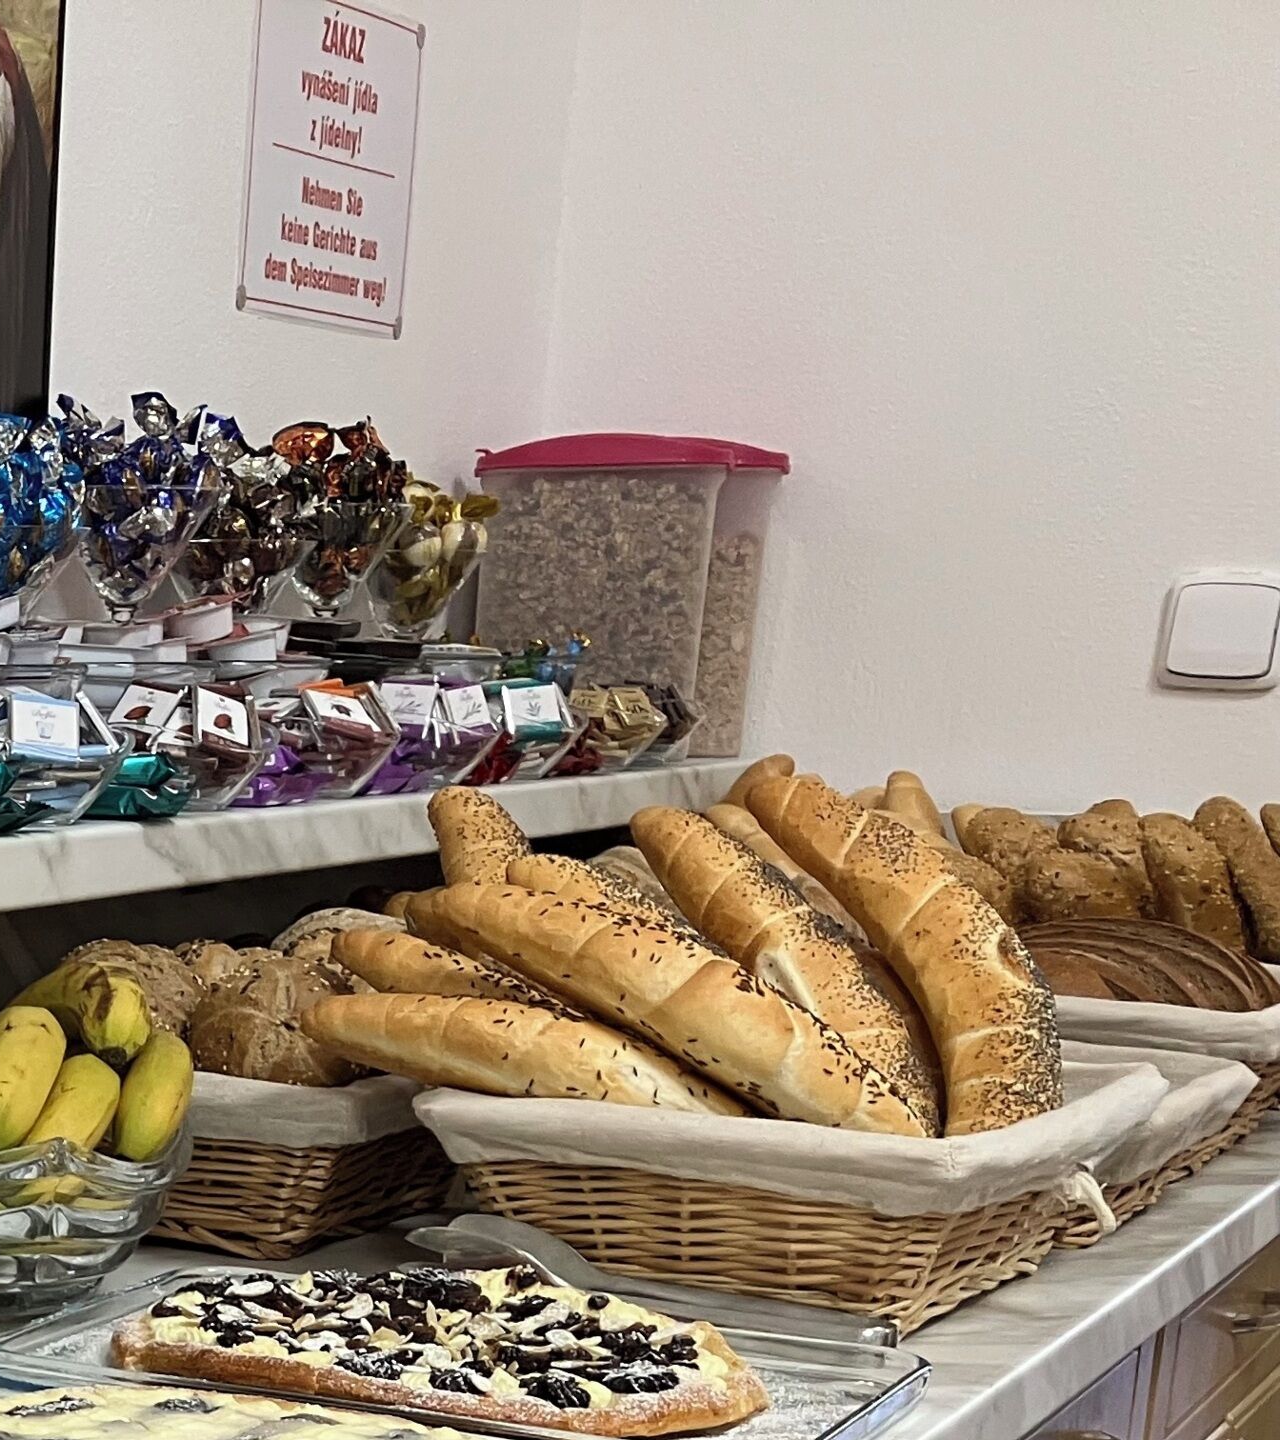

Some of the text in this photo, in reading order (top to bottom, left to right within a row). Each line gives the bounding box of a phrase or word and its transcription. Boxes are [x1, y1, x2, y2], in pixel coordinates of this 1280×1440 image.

[321, 10, 366, 64] ZÁKAZ
[301, 69, 379, 115] vynášení jídla
[310, 115, 363, 159] z jídelny!
[301, 176, 363, 217] Nehmen Sie
[280, 213, 378, 261] keine Gerichte aus
[264, 252, 387, 308] dem Speisezimmer weg!
